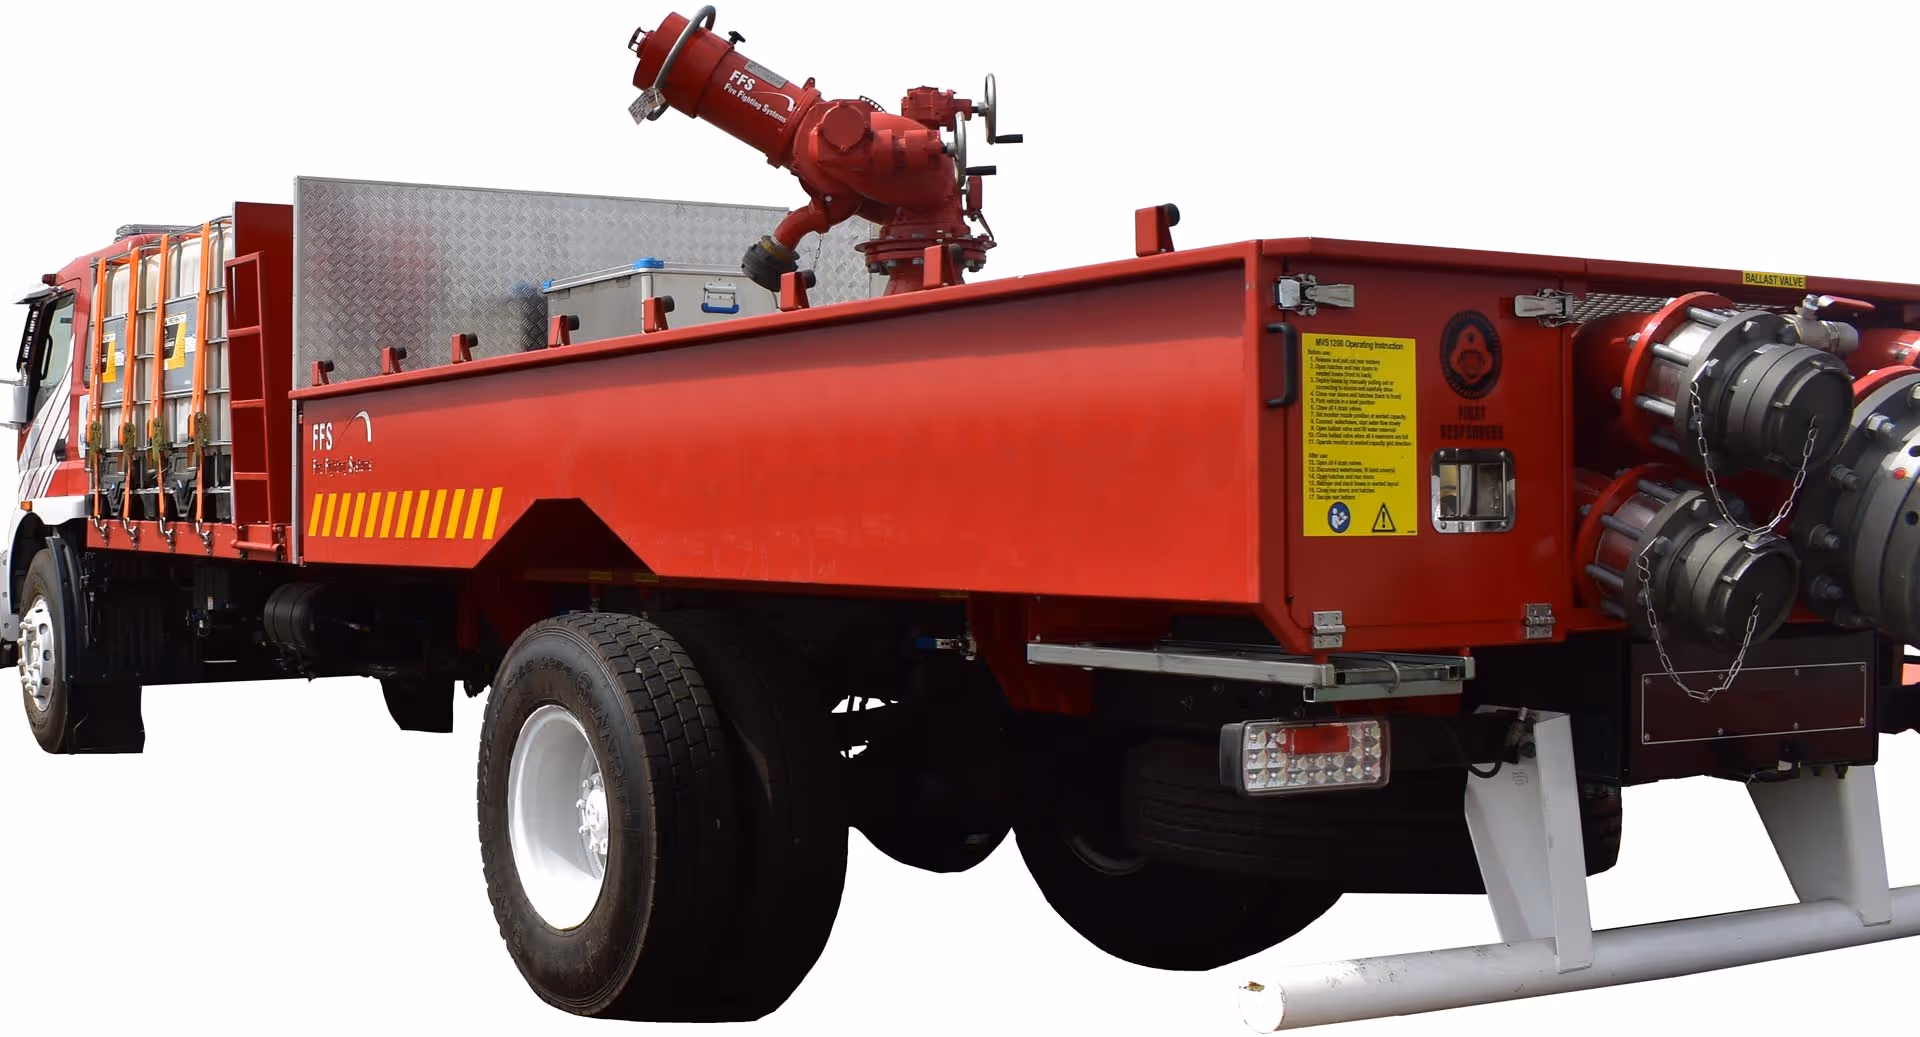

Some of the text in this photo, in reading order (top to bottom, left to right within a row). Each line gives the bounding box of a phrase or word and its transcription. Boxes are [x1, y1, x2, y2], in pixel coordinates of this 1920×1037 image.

[729, 70, 756, 90] FFS
[724, 82, 786, 123] Fire Fighting Systems
[1745, 273, 1803, 287] BALLAST VALVE
[1345, 340, 1374, 350] Operating
[1375, 342, 1404, 350] Instruction
[313, 422, 333, 451] FFS
